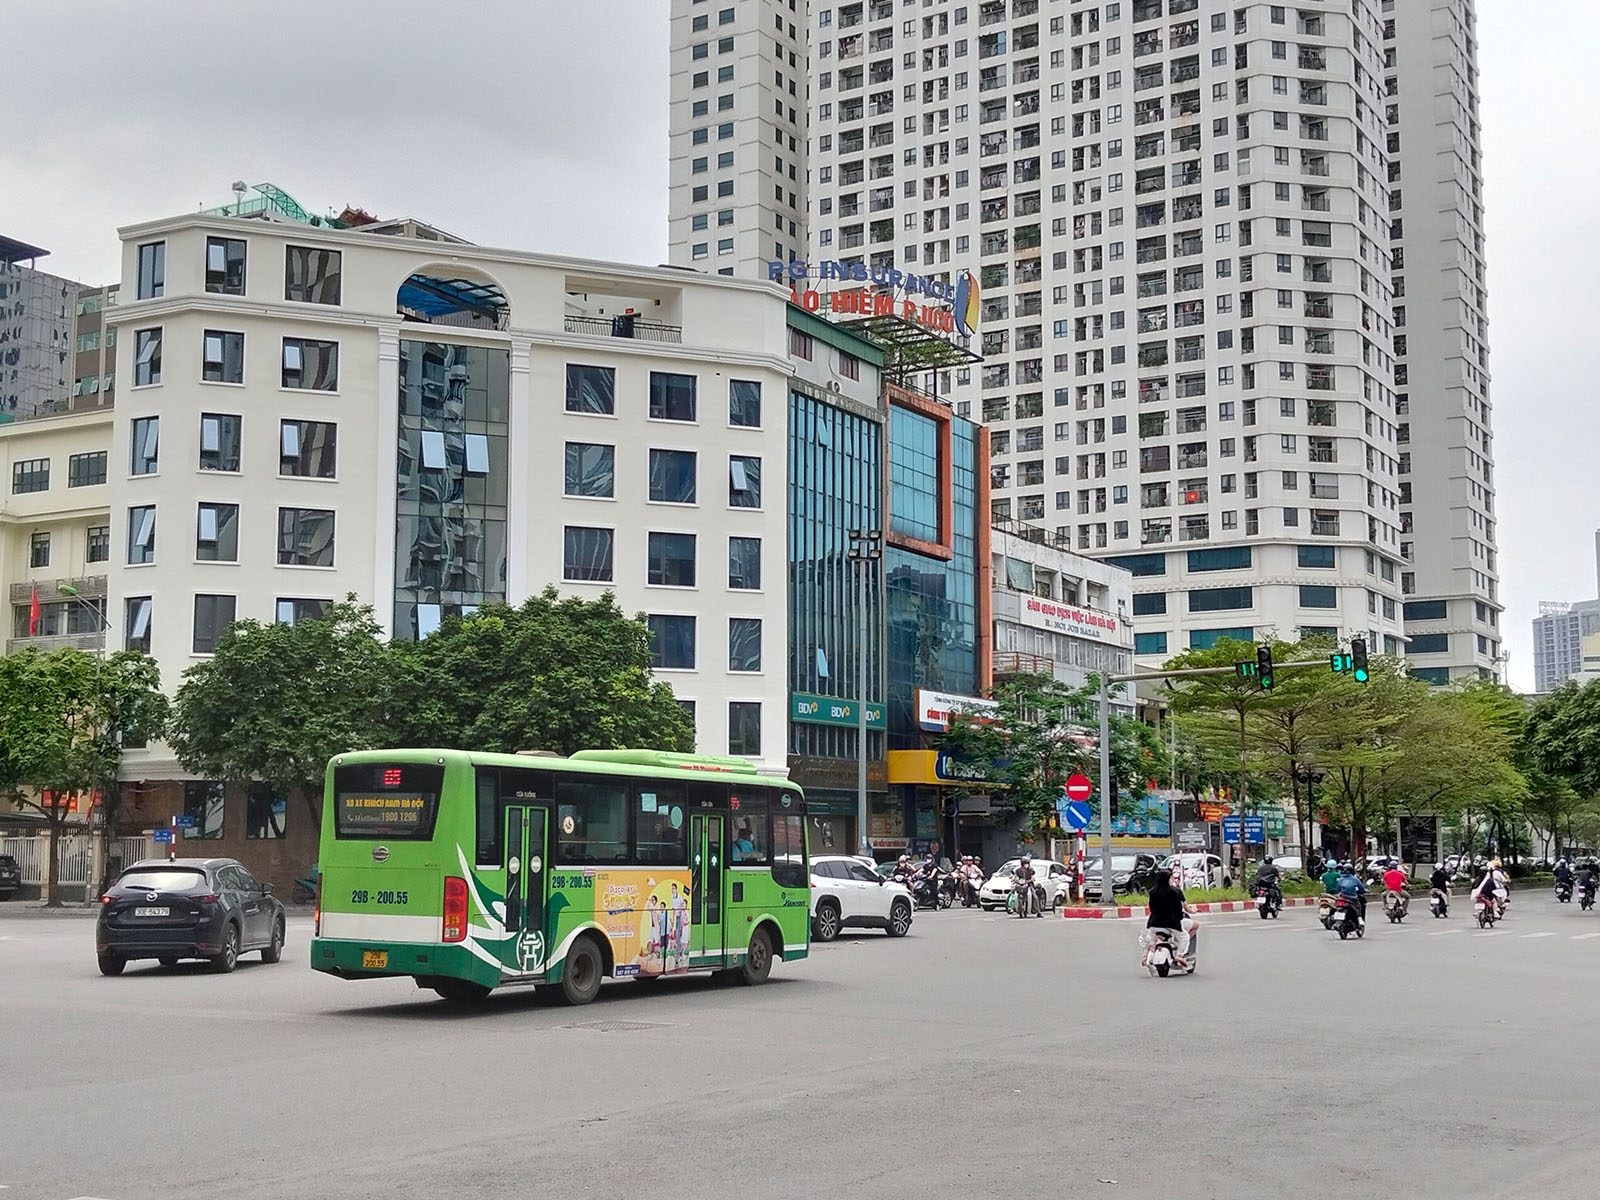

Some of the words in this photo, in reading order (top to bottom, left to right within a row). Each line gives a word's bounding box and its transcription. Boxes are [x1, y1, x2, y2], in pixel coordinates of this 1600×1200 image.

[768, 261, 807, 280] PG
[820, 260, 955, 303] INSURANCE
[790, 284, 819, 313] ẢO
[832, 286, 893, 316] HIỂM
[903, 300, 953, 333] PJICO
[1041, 603, 1056, 616] GIAO
[1071, 610, 1084, 624] VIỆC
[1085, 612, 1097, 625] LÀM
[1067, 624, 1079, 633] JOB
[1242, 663, 1254, 676] 11
[1333, 656, 1351, 671] 31
[798, 701, 817, 714] BIDV
[831, 705, 849, 718] BIDV
[552, 876, 565, 888] 29B
[570, 876, 592, 888] 200.55
[352, 890, 368, 903] 29B
[377, 891, 408, 904] 200.55
